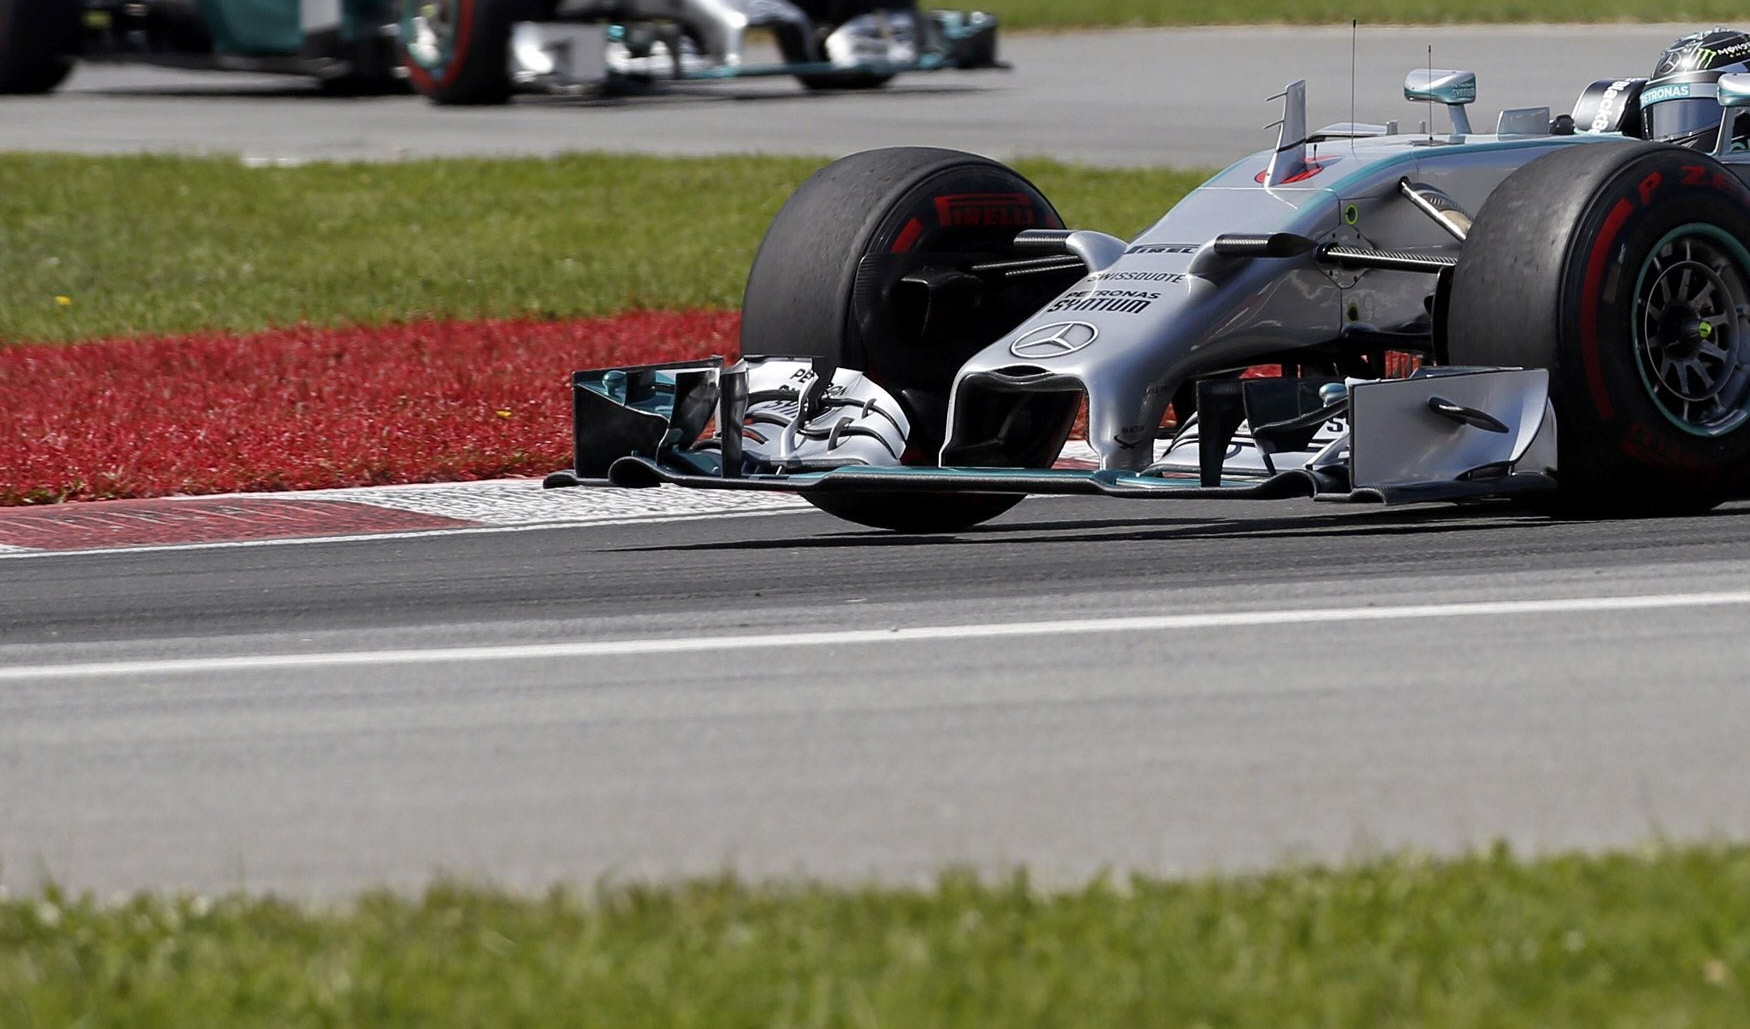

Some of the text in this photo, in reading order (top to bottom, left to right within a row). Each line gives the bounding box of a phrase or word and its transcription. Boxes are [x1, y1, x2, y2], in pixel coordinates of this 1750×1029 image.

[1122, 243, 1202, 255] PIREL
[1086, 271, 1187, 284] SWISSQUOTE
[1065, 289, 1162, 300] PETRONAS
